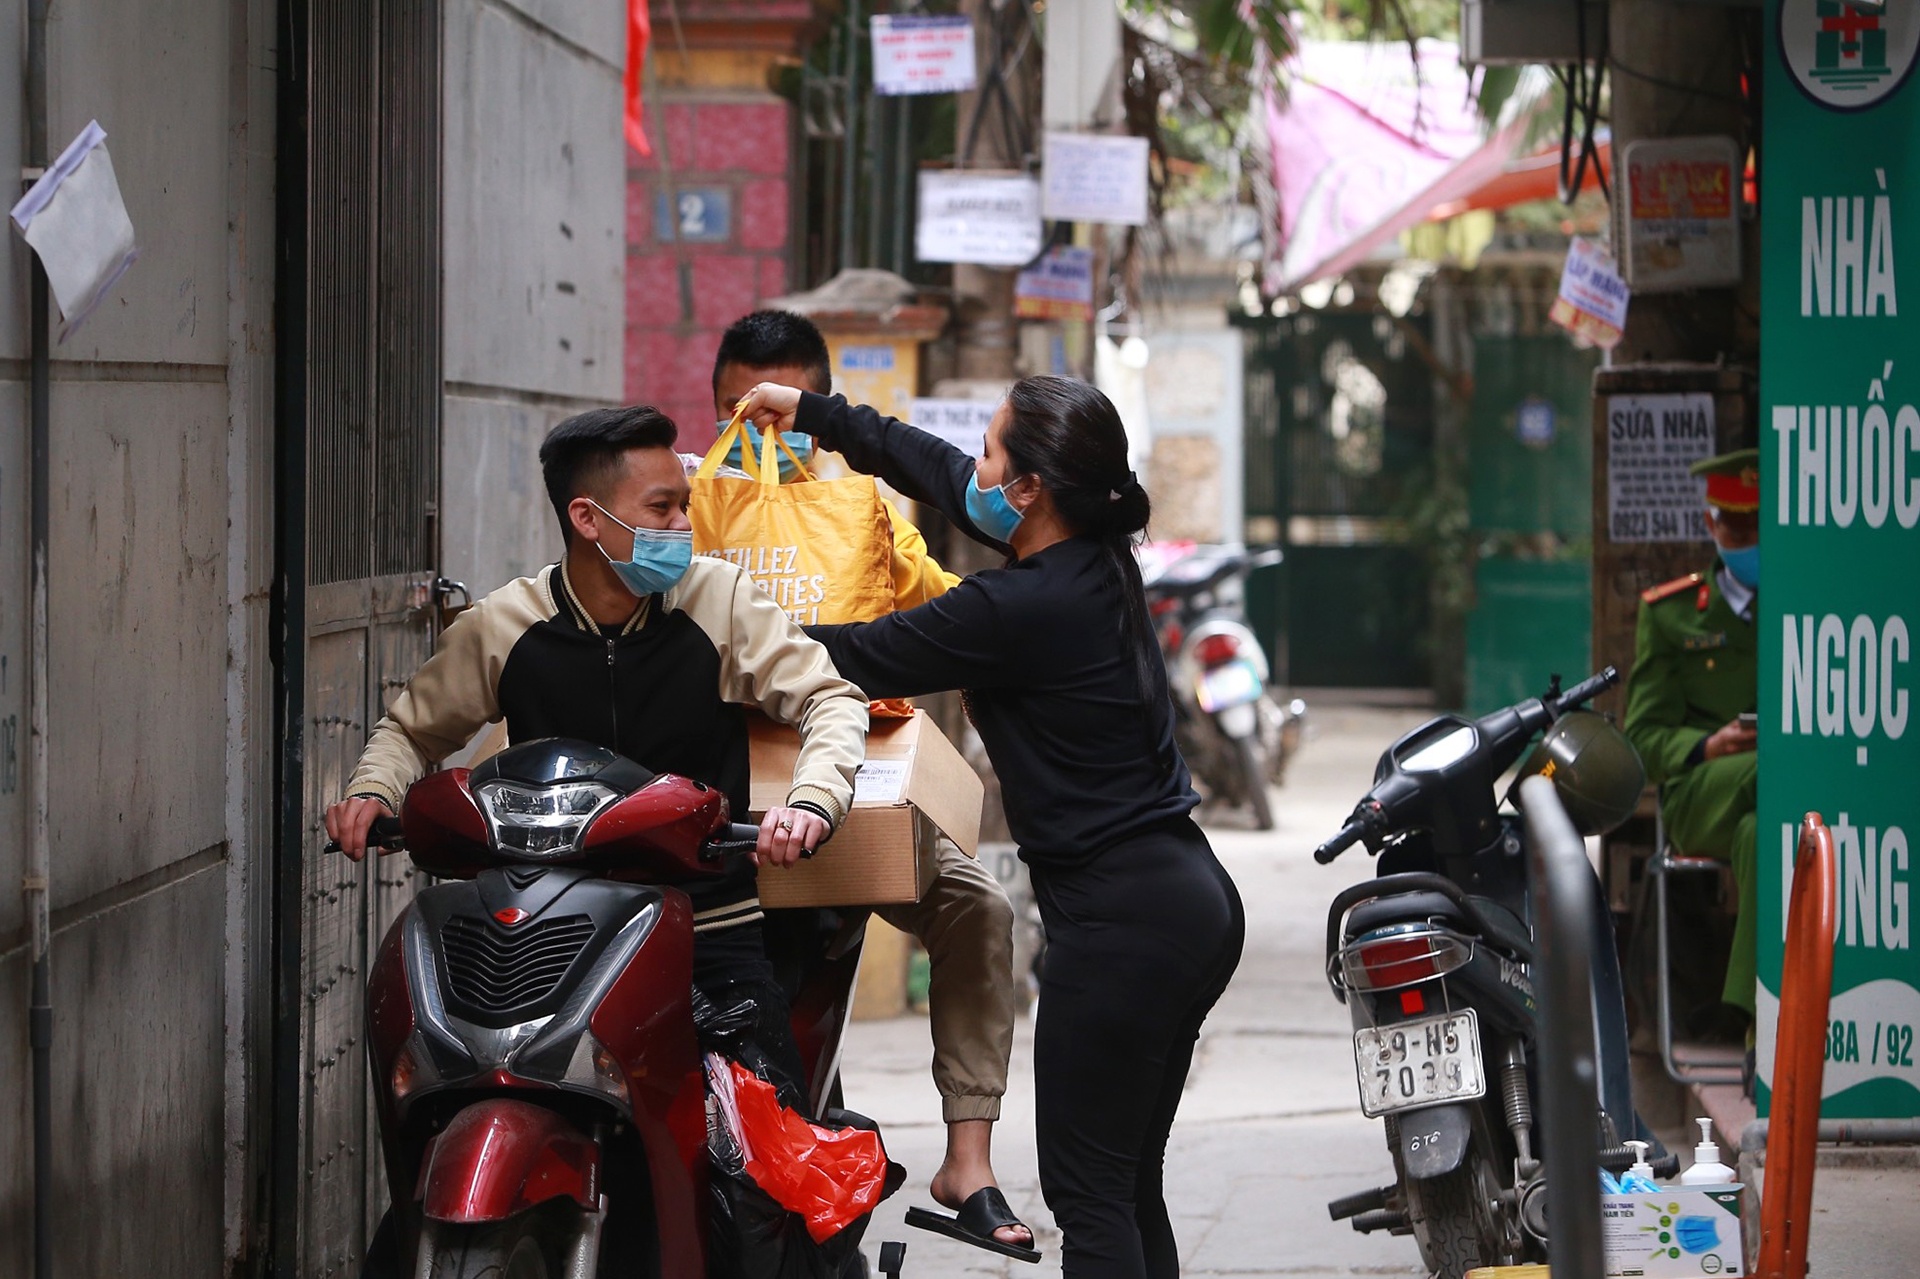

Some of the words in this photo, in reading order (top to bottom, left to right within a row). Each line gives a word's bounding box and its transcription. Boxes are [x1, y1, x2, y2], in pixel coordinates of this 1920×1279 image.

[680, 194, 704, 234] 2
[1801, 168, 1898, 317] NHÀ
[1611, 398, 1655, 440] SỬA
[1662, 406, 1708, 439] NHÀ
[1772, 360, 1920, 529] THUỐC
[1781, 613, 1910, 766] NGỌC
[1781, 812, 1910, 951] NG
[1886, 1023, 1913, 1067] 92
